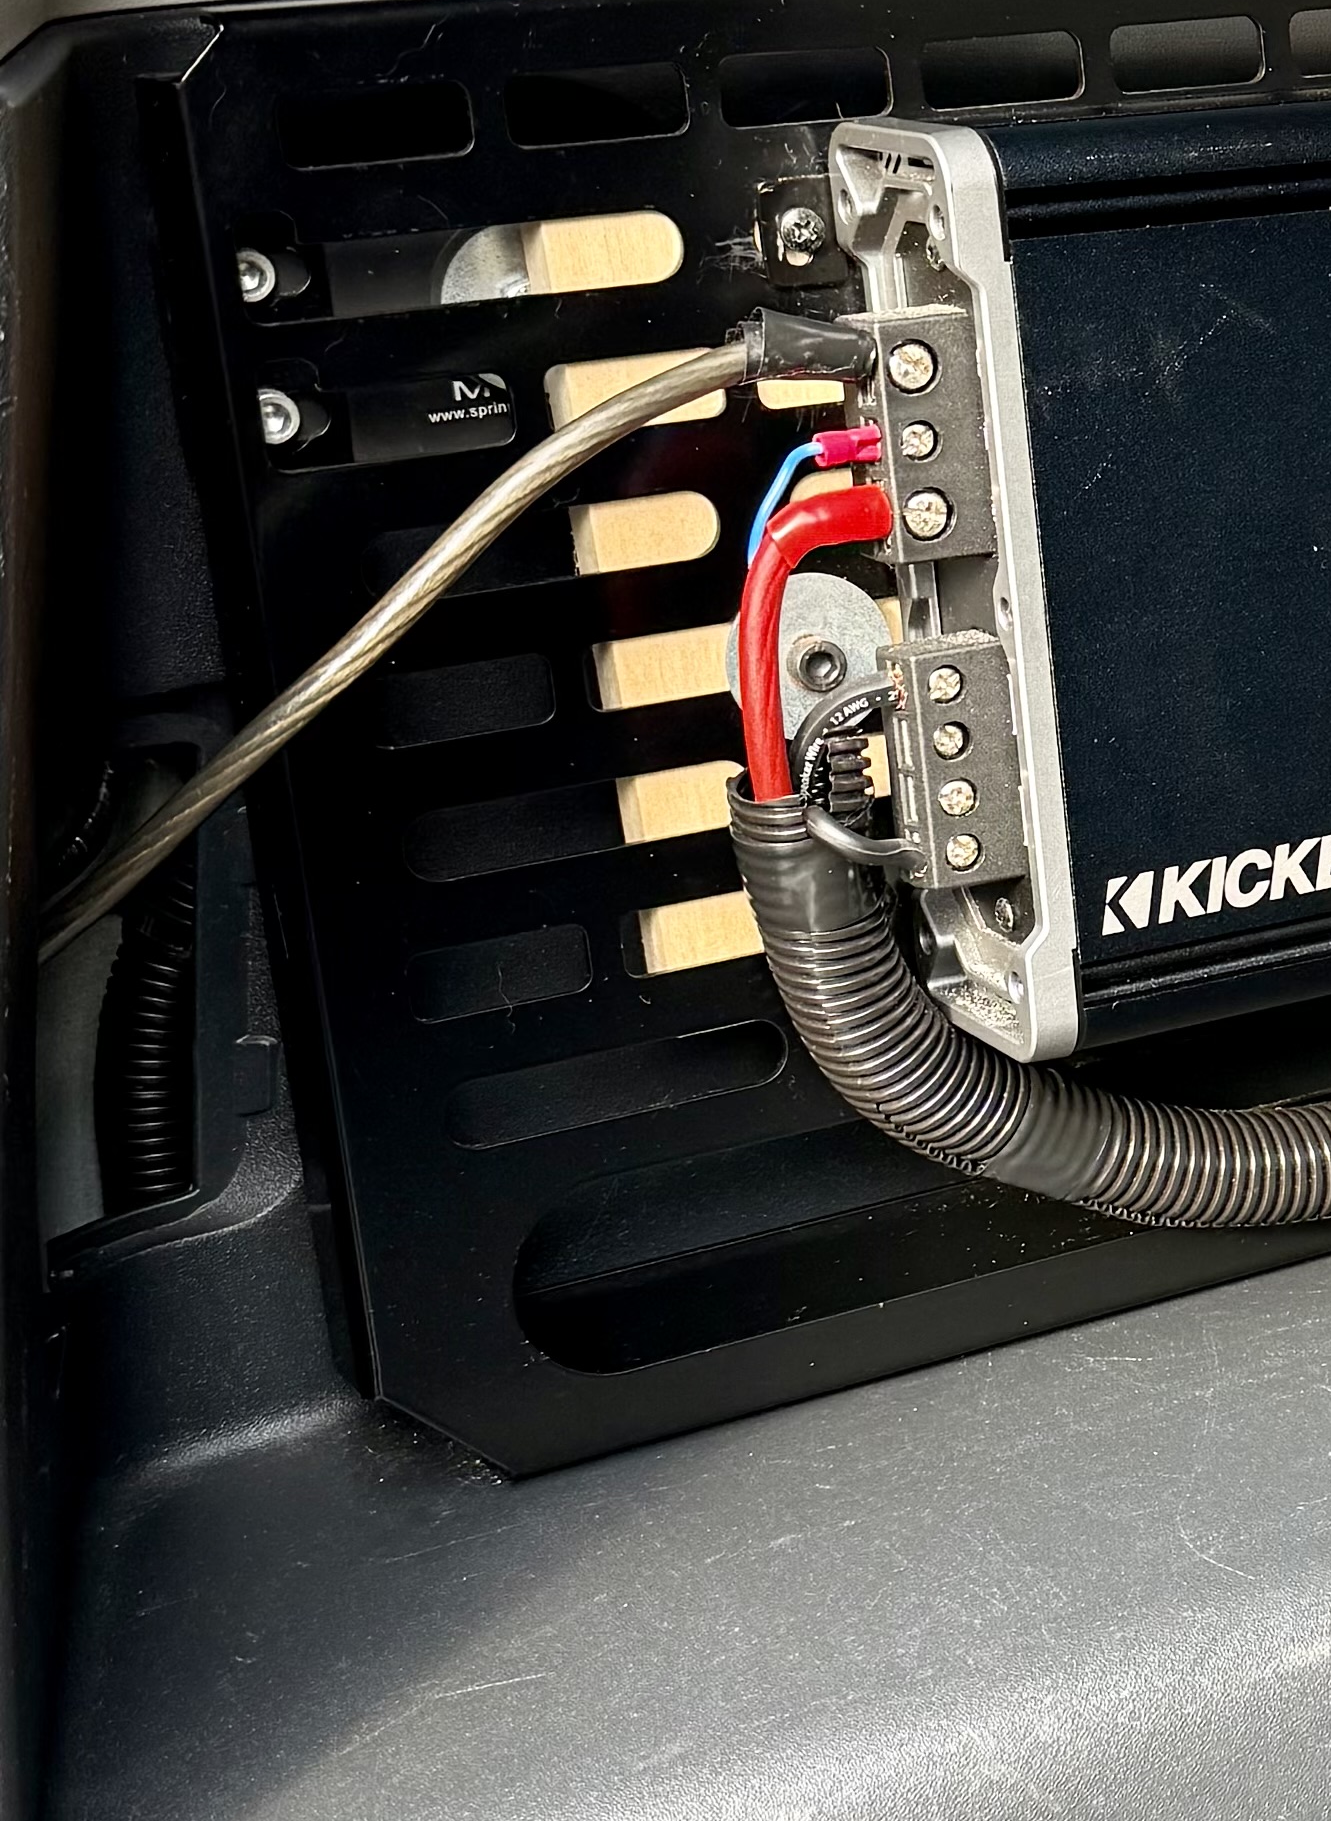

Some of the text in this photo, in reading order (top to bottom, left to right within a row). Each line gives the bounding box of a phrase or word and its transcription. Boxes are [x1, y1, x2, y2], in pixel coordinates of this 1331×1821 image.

[428, 401, 511, 423] www.sprin
[804, 737, 825, 761] Wire
[829, 711, 844, 726] 12
[842, 697, 869, 717] AWG
